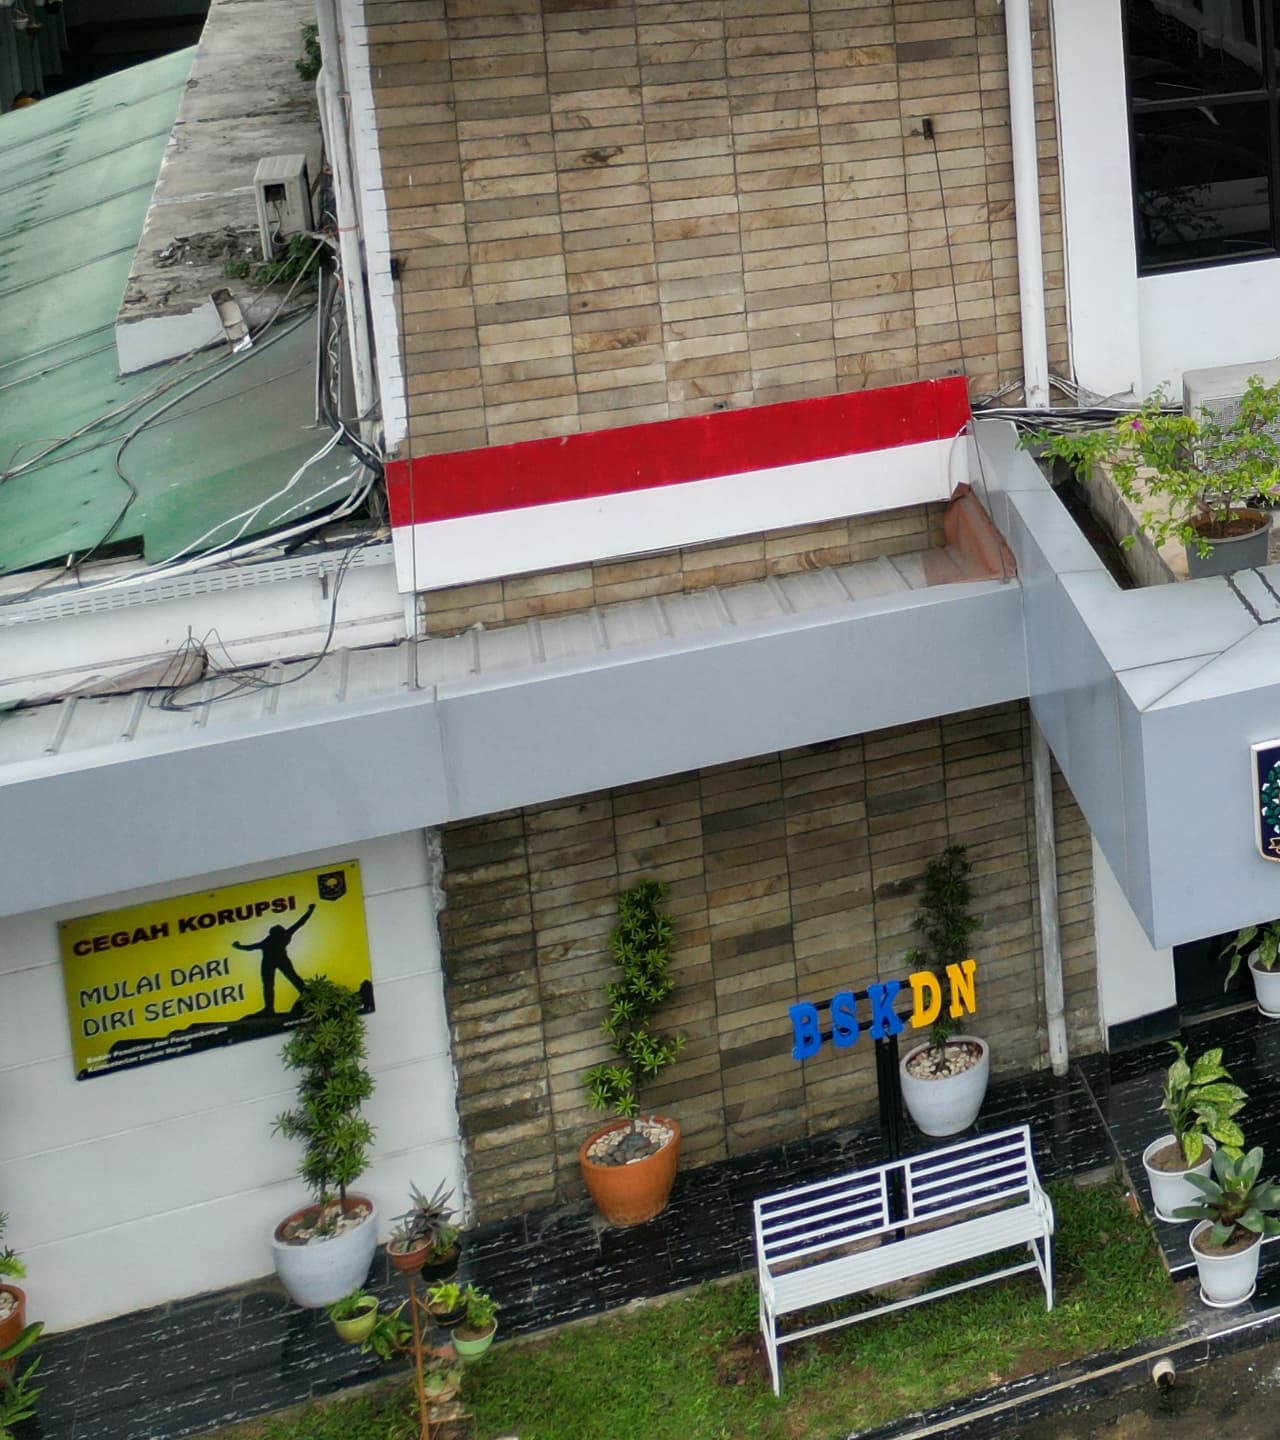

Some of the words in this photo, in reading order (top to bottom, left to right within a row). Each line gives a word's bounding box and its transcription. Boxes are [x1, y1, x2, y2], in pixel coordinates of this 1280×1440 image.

[73, 923, 169, 956] CEGAH
[178, 896, 296, 933] KORUPSI
[79, 973, 161, 1008] MULAI
[170, 958, 230, 987] DARI
[82, 1008, 135, 1037] DIRI
[144, 984, 245, 1022] SENDIRI
[788, 959, 976, 1060] BSKDN
